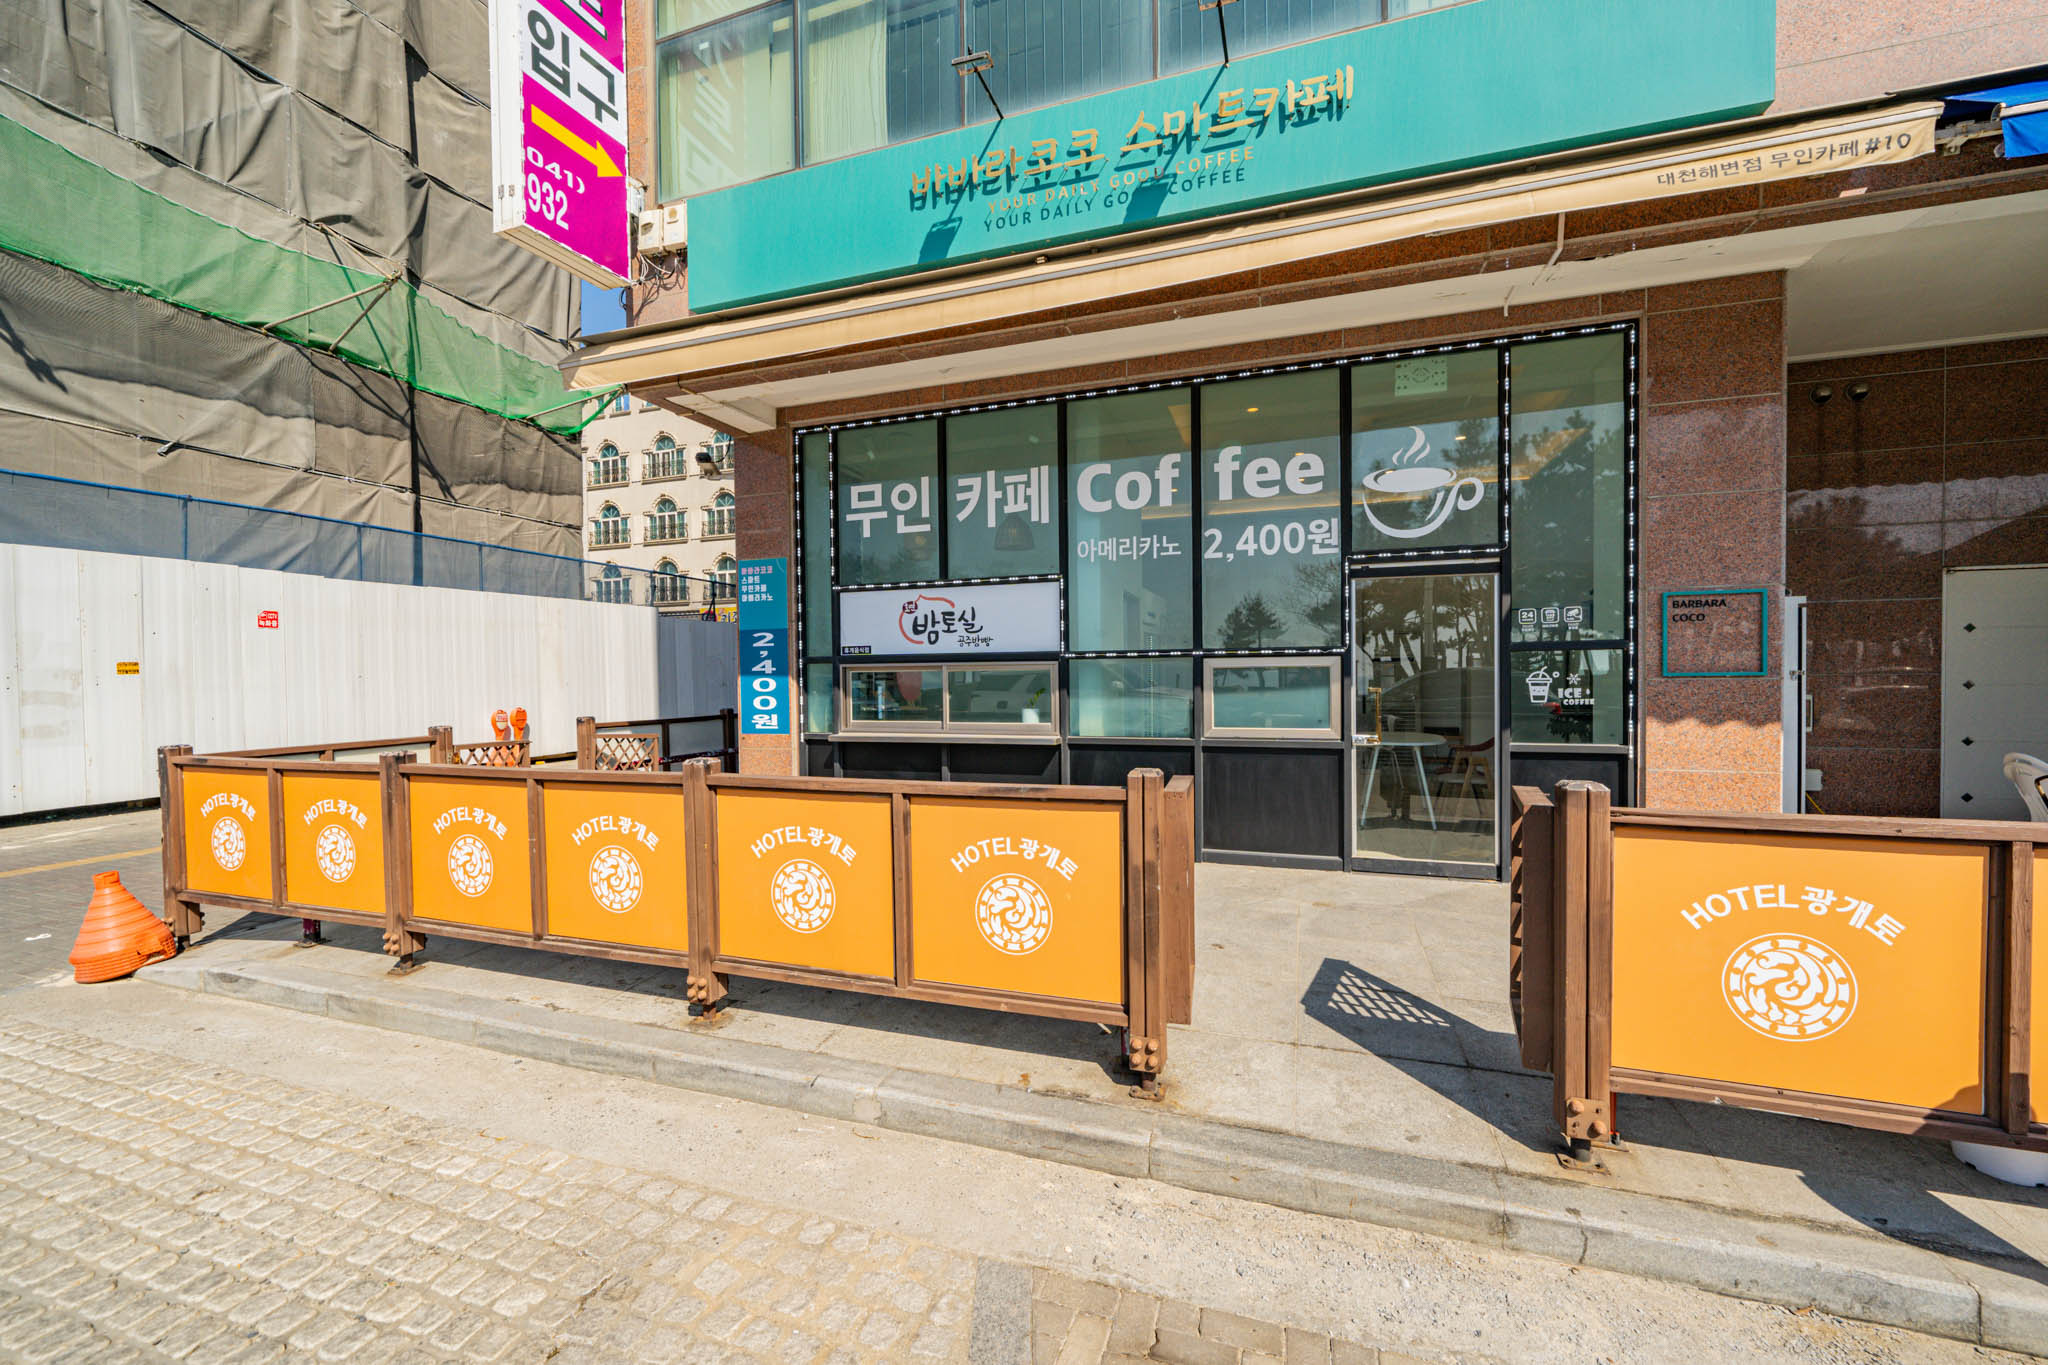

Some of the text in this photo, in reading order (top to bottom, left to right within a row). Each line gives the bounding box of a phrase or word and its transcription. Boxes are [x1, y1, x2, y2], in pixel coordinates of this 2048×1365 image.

[528, 10, 619, 122] 입구
[911, 64, 1355, 193] 바바라코코 스마트카페
[526, 146, 585, 195] 041)
[988, 146, 1255, 215] YOUR DAILY GOOD COFFEE
[1656, 132, 1912, 186] 대천해변점 무인카페 #10
[527, 172, 570, 230] 932
[845, 476, 932, 538] 무인
[955, 465, 1050, 528] 카페
[1076, 516, 1340, 563] 아메리카노 2,400원
[912, 606, 984, 645] 밤토실
[1672, 598, 1727, 609] BARBARA
[1672, 613, 1706, 623] COCO
[1557, 688, 1582, 698] ICE
[1563, 698, 1595, 706] COFFEE
